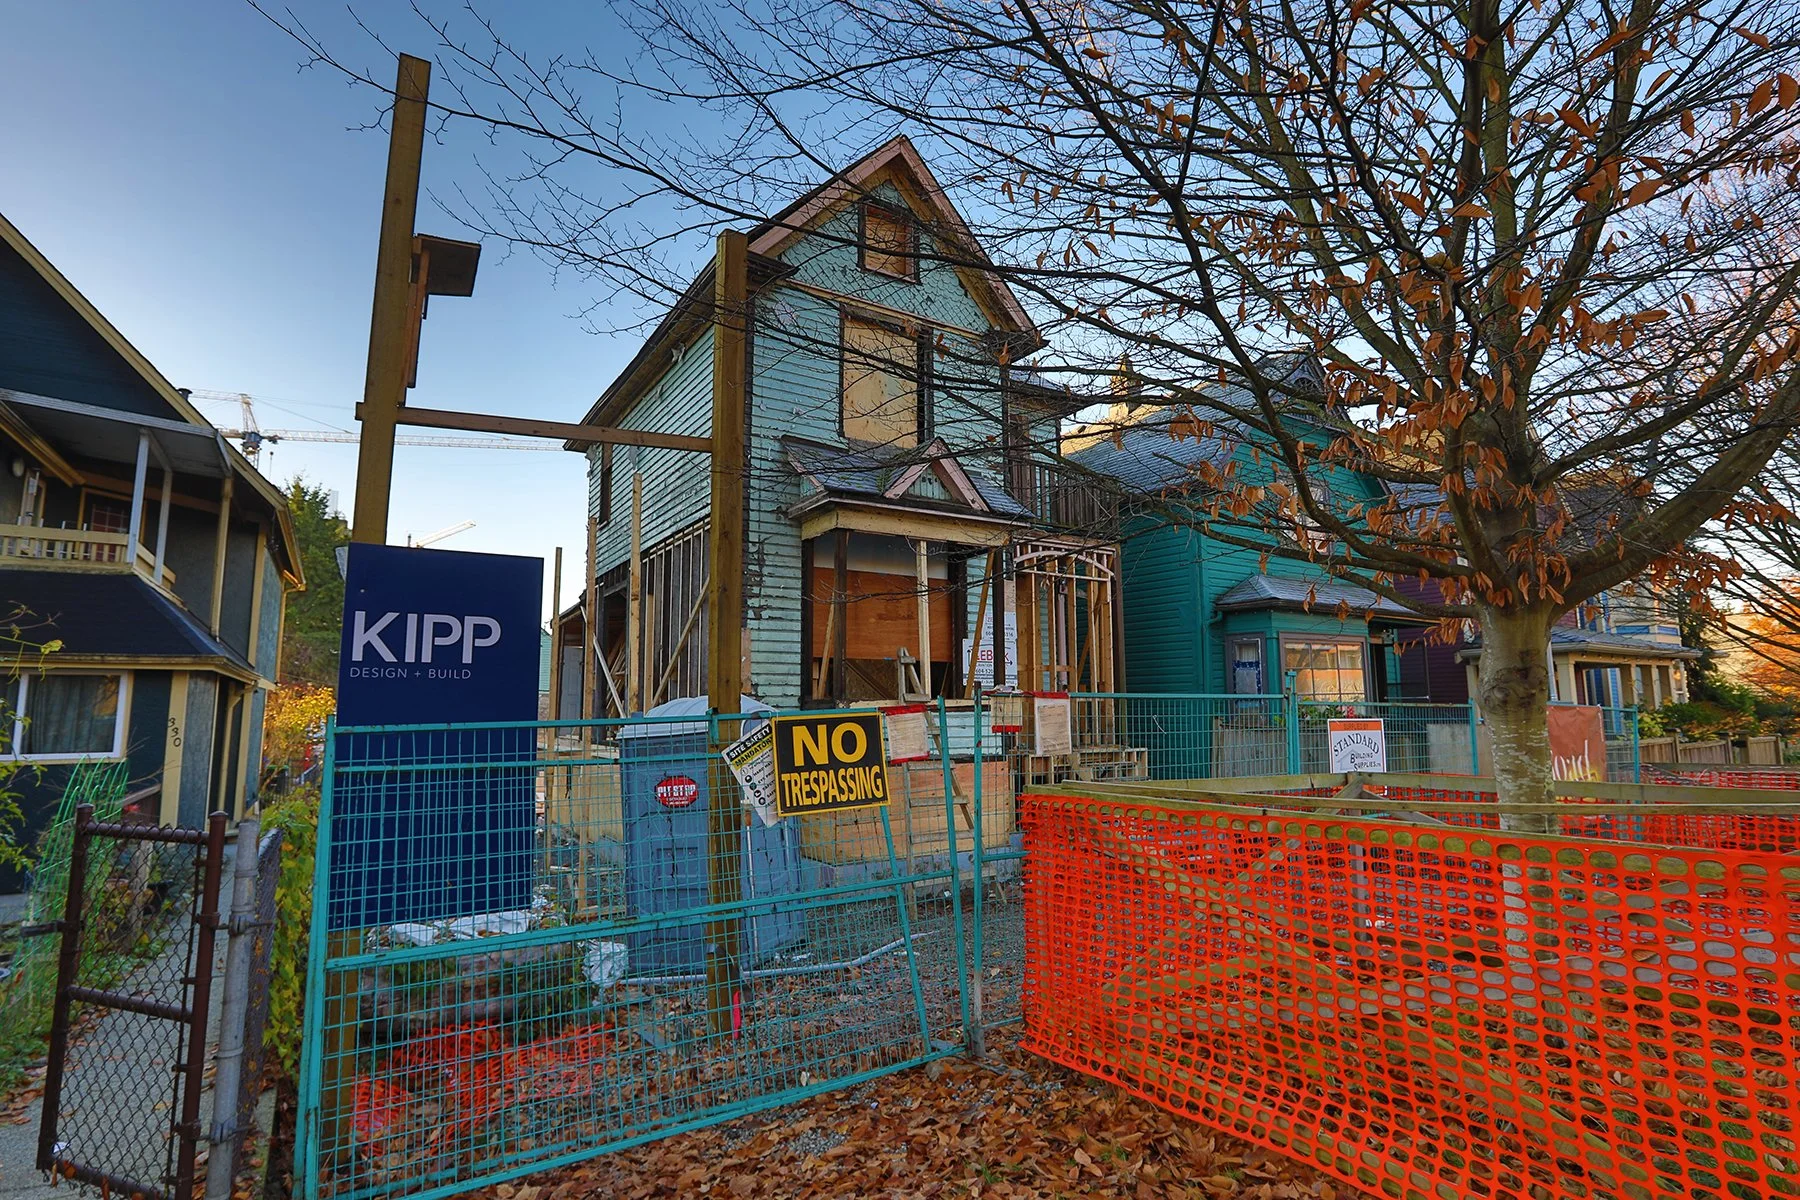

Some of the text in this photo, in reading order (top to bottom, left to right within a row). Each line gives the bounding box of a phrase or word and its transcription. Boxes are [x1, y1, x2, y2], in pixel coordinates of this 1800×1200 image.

[351, 611, 501, 664] KIPP
[350, 667, 408, 678] DESIGN
[428, 668, 471, 679] BUILD
[167, 717, 182, 747] 330
[729, 743, 746, 759] SITE
[745, 726, 771, 746] SAFETY
[792, 722, 867, 767] NO
[1333, 733, 1379, 757] STANDARD
[657, 785, 672, 797] PIT
[781, 765, 884, 808] TRESPASSING
